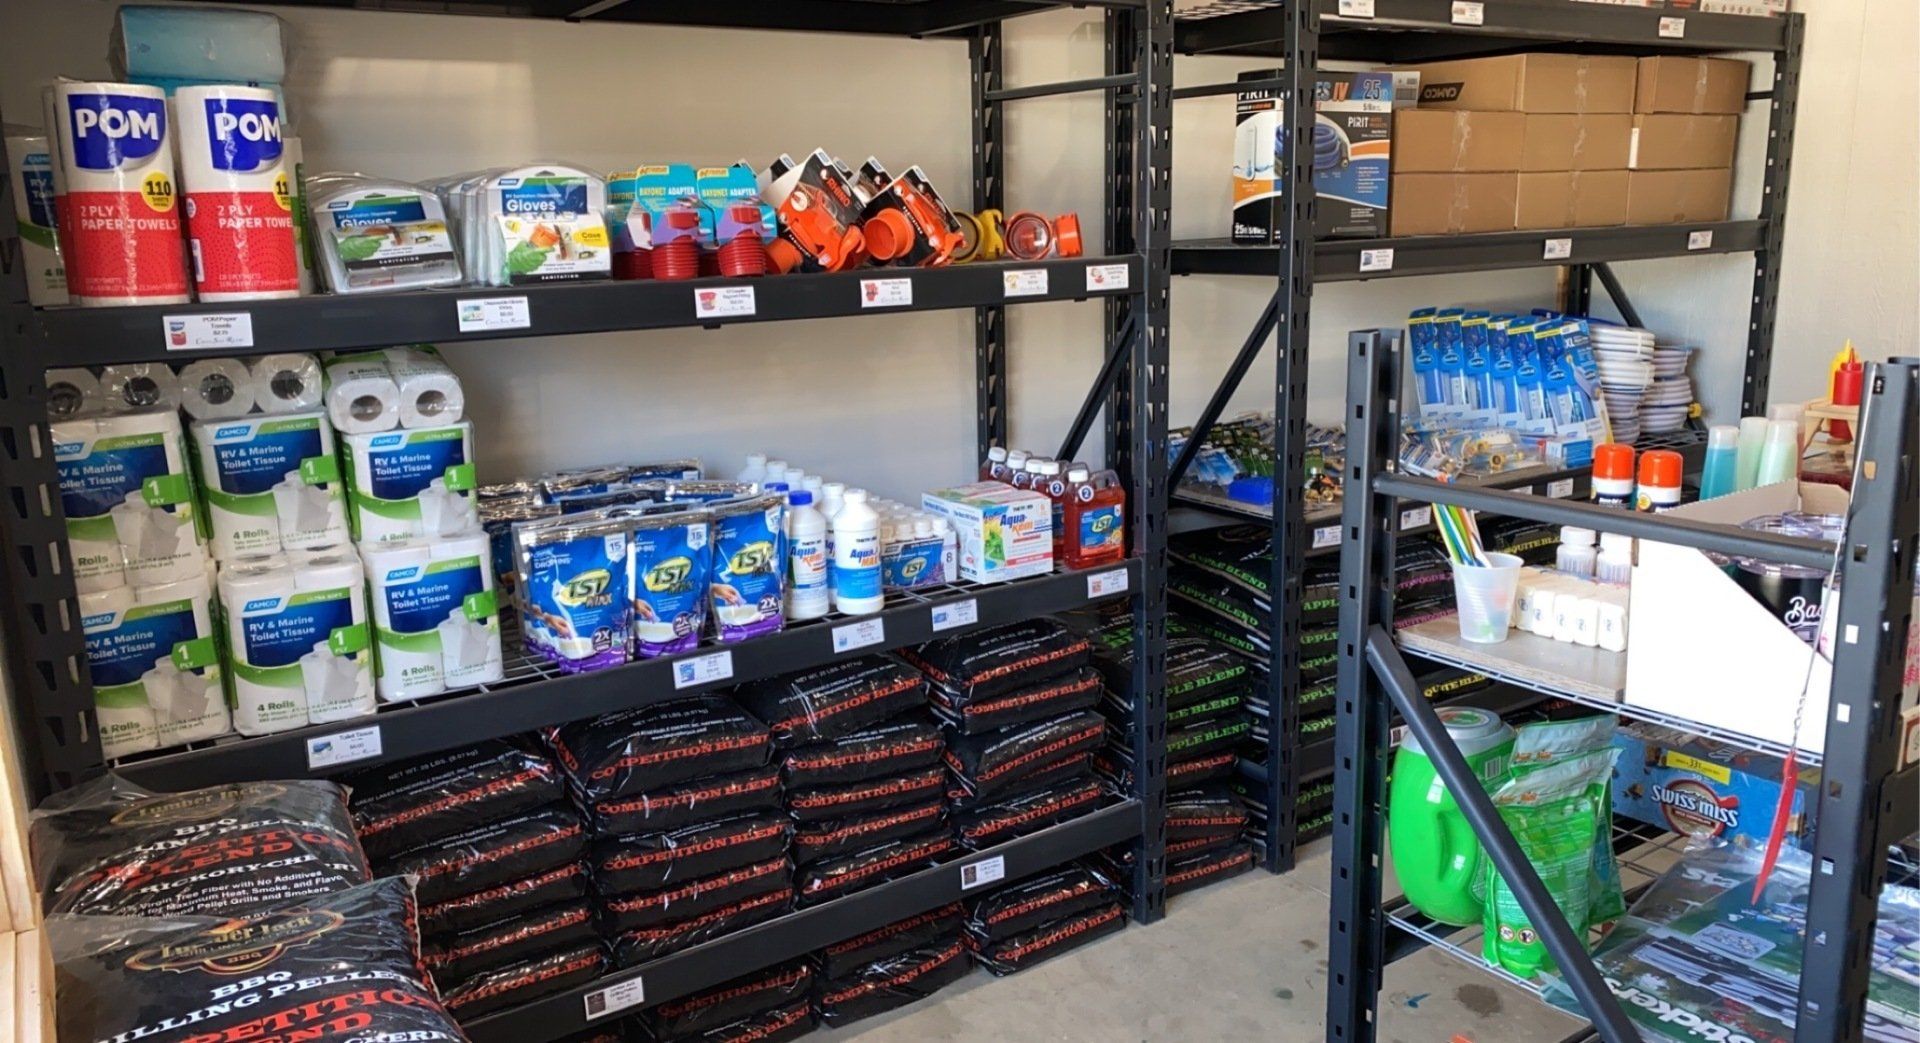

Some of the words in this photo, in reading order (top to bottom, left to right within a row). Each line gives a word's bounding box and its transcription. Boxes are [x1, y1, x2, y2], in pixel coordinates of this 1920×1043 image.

[75, 107, 159, 141] POM
[213, 113, 283, 142] POM
[1348, 117, 1370, 131] PIRIT
[148, 179, 171, 198] 110
[730, 188, 757, 197] ADAPTER
[81, 204, 88, 218] 2
[90, 203, 115, 219] PLY
[229, 203, 253, 218] PLY
[507, 199, 557, 213] Gloves
[218, 426, 249, 438] CAMCO
[220, 447, 239, 460] RV
[240, 447, 248, 458] &
[249, 444, 285, 457] Marine
[375, 457, 389, 467] RV
[391, 456, 399, 465] &
[400, 453, 432, 465] Marine
[82, 457, 125, 476] Marine
[222, 458, 253, 470] Toilet
[254, 455, 288, 467] Tissue
[305, 461, 315, 476] 1
[376, 466, 402, 477] Toilet
[404, 463, 433, 474] Tissue
[89, 475, 126, 487] Tissue
[148, 480, 160, 496] 1
[1083, 488, 1091, 499] 2
[233, 531, 242, 541] 4
[243, 529, 270, 541] Rolls
[609, 542, 622, 552] 15
[849, 548, 875, 563] Aqua
[945, 551, 953, 563] 8
[389, 568, 416, 580] CAMCO
[651, 563, 687, 586] TST
[1225, 565, 1268, 591] BLEND
[391, 589, 406, 600] RV
[407, 588, 416, 598] &
[417, 583, 450, 595] Marine
[568, 576, 609, 599] TST
[247, 599, 279, 610] CAMCO
[392, 598, 420, 610] Toilet
[420, 594, 451, 605] Tissue
[467, 596, 477, 612] 1
[759, 598, 778, 611] 2X
[1218, 600, 1260, 626] BLEND
[249, 622, 267, 635] RV
[268, 620, 277, 633] &
[278, 615, 315, 629] Marine
[103, 638, 112, 648] &
[114, 630, 155, 644] Marine
[250, 632, 281, 646] Toilet
[282, 627, 316, 640] Tissue
[335, 629, 345, 646] 1
[593, 629, 612, 643] 2X
[87, 646, 119, 660] Toilet
[120, 640, 156, 655] Tissue
[178, 645, 189, 661] 1
[401, 668, 409, 677] 4
[411, 664, 435, 675] Rolls
[1195, 665, 1247, 687] BLEND
[257, 704, 266, 716] 4
[267, 700, 296, 714] Rolls
[1190, 695, 1240, 716] BLEND
[109, 723, 141, 737] Rolls
[1204, 721, 1250, 744] BLEND
[1651, 783, 1698, 812] SWISS
[139, 898, 174, 912] Virgin
[175, 892, 201, 904] Tree
[202, 887, 231, 900] Fiber
[232, 883, 256, 895] with
[257, 880, 272, 891] No
[274, 870, 324, 888] Additives
[166, 894, 220, 913] Maximum
[221, 889, 248, 903] Heat,
[251, 884, 290, 900] Smoke,
[292, 880, 313, 893] and
[162, 907, 196, 920] Wood
[197, 901, 229, 914] Pellet
[231, 895, 262, 909] Grills
[263, 891, 284, 905] and
[210, 970, 294, 1001] BBQ
